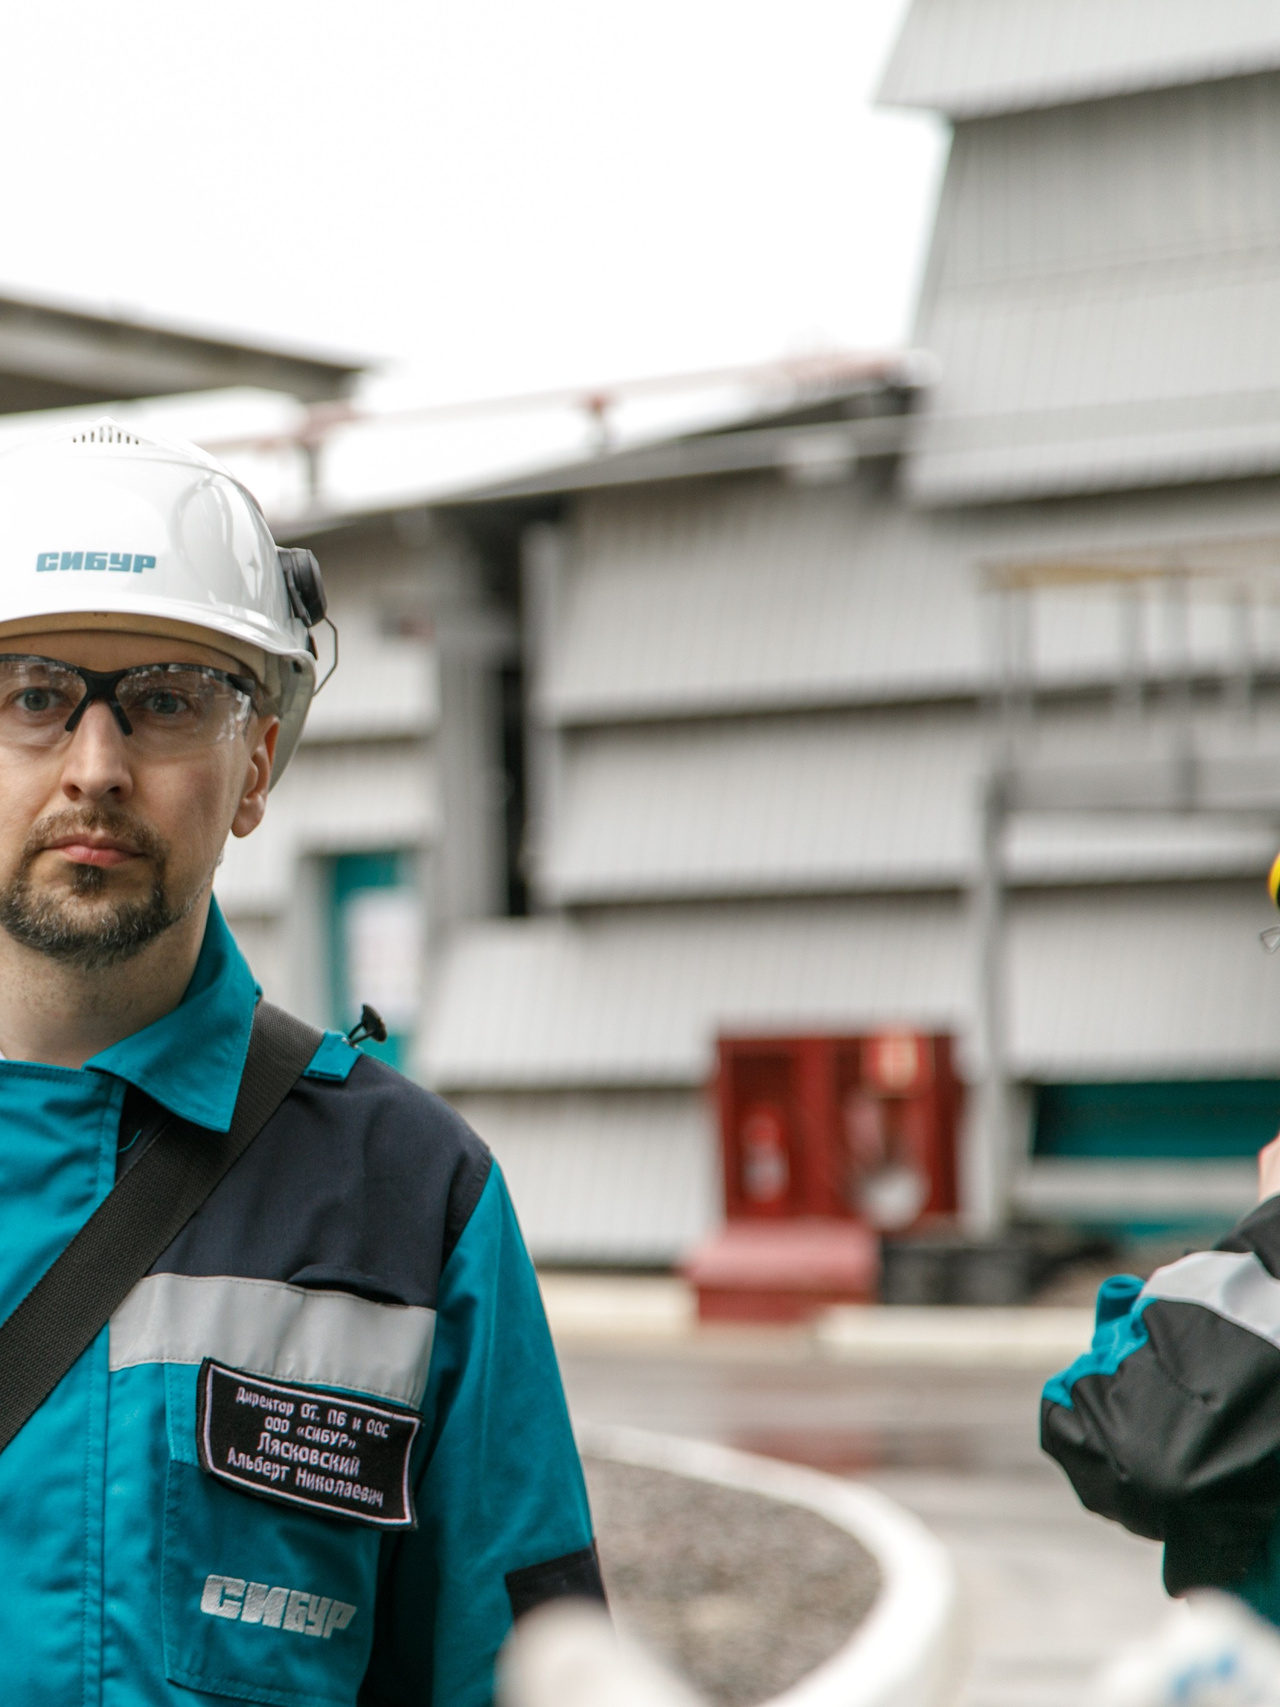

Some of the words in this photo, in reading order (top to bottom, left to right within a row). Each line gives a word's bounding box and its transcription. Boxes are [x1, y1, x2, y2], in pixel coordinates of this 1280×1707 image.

[36, 551, 156, 573] СИБУР
[236, 1386, 294, 1416] Директор
[327, 1409, 347, 1427] ПБ
[352, 1416, 362, 1432] и
[366, 1419, 390, 1438] ООС
[264, 1416, 290, 1434] ООО
[296, 1424, 357, 1449] «СИБУР»
[227, 1447, 290, 1482] Альберт
[295, 1467, 384, 1507] Николаевич
[257, 1431, 361, 1477] Лясковский
[200, 1574, 357, 1639] СИБУР
